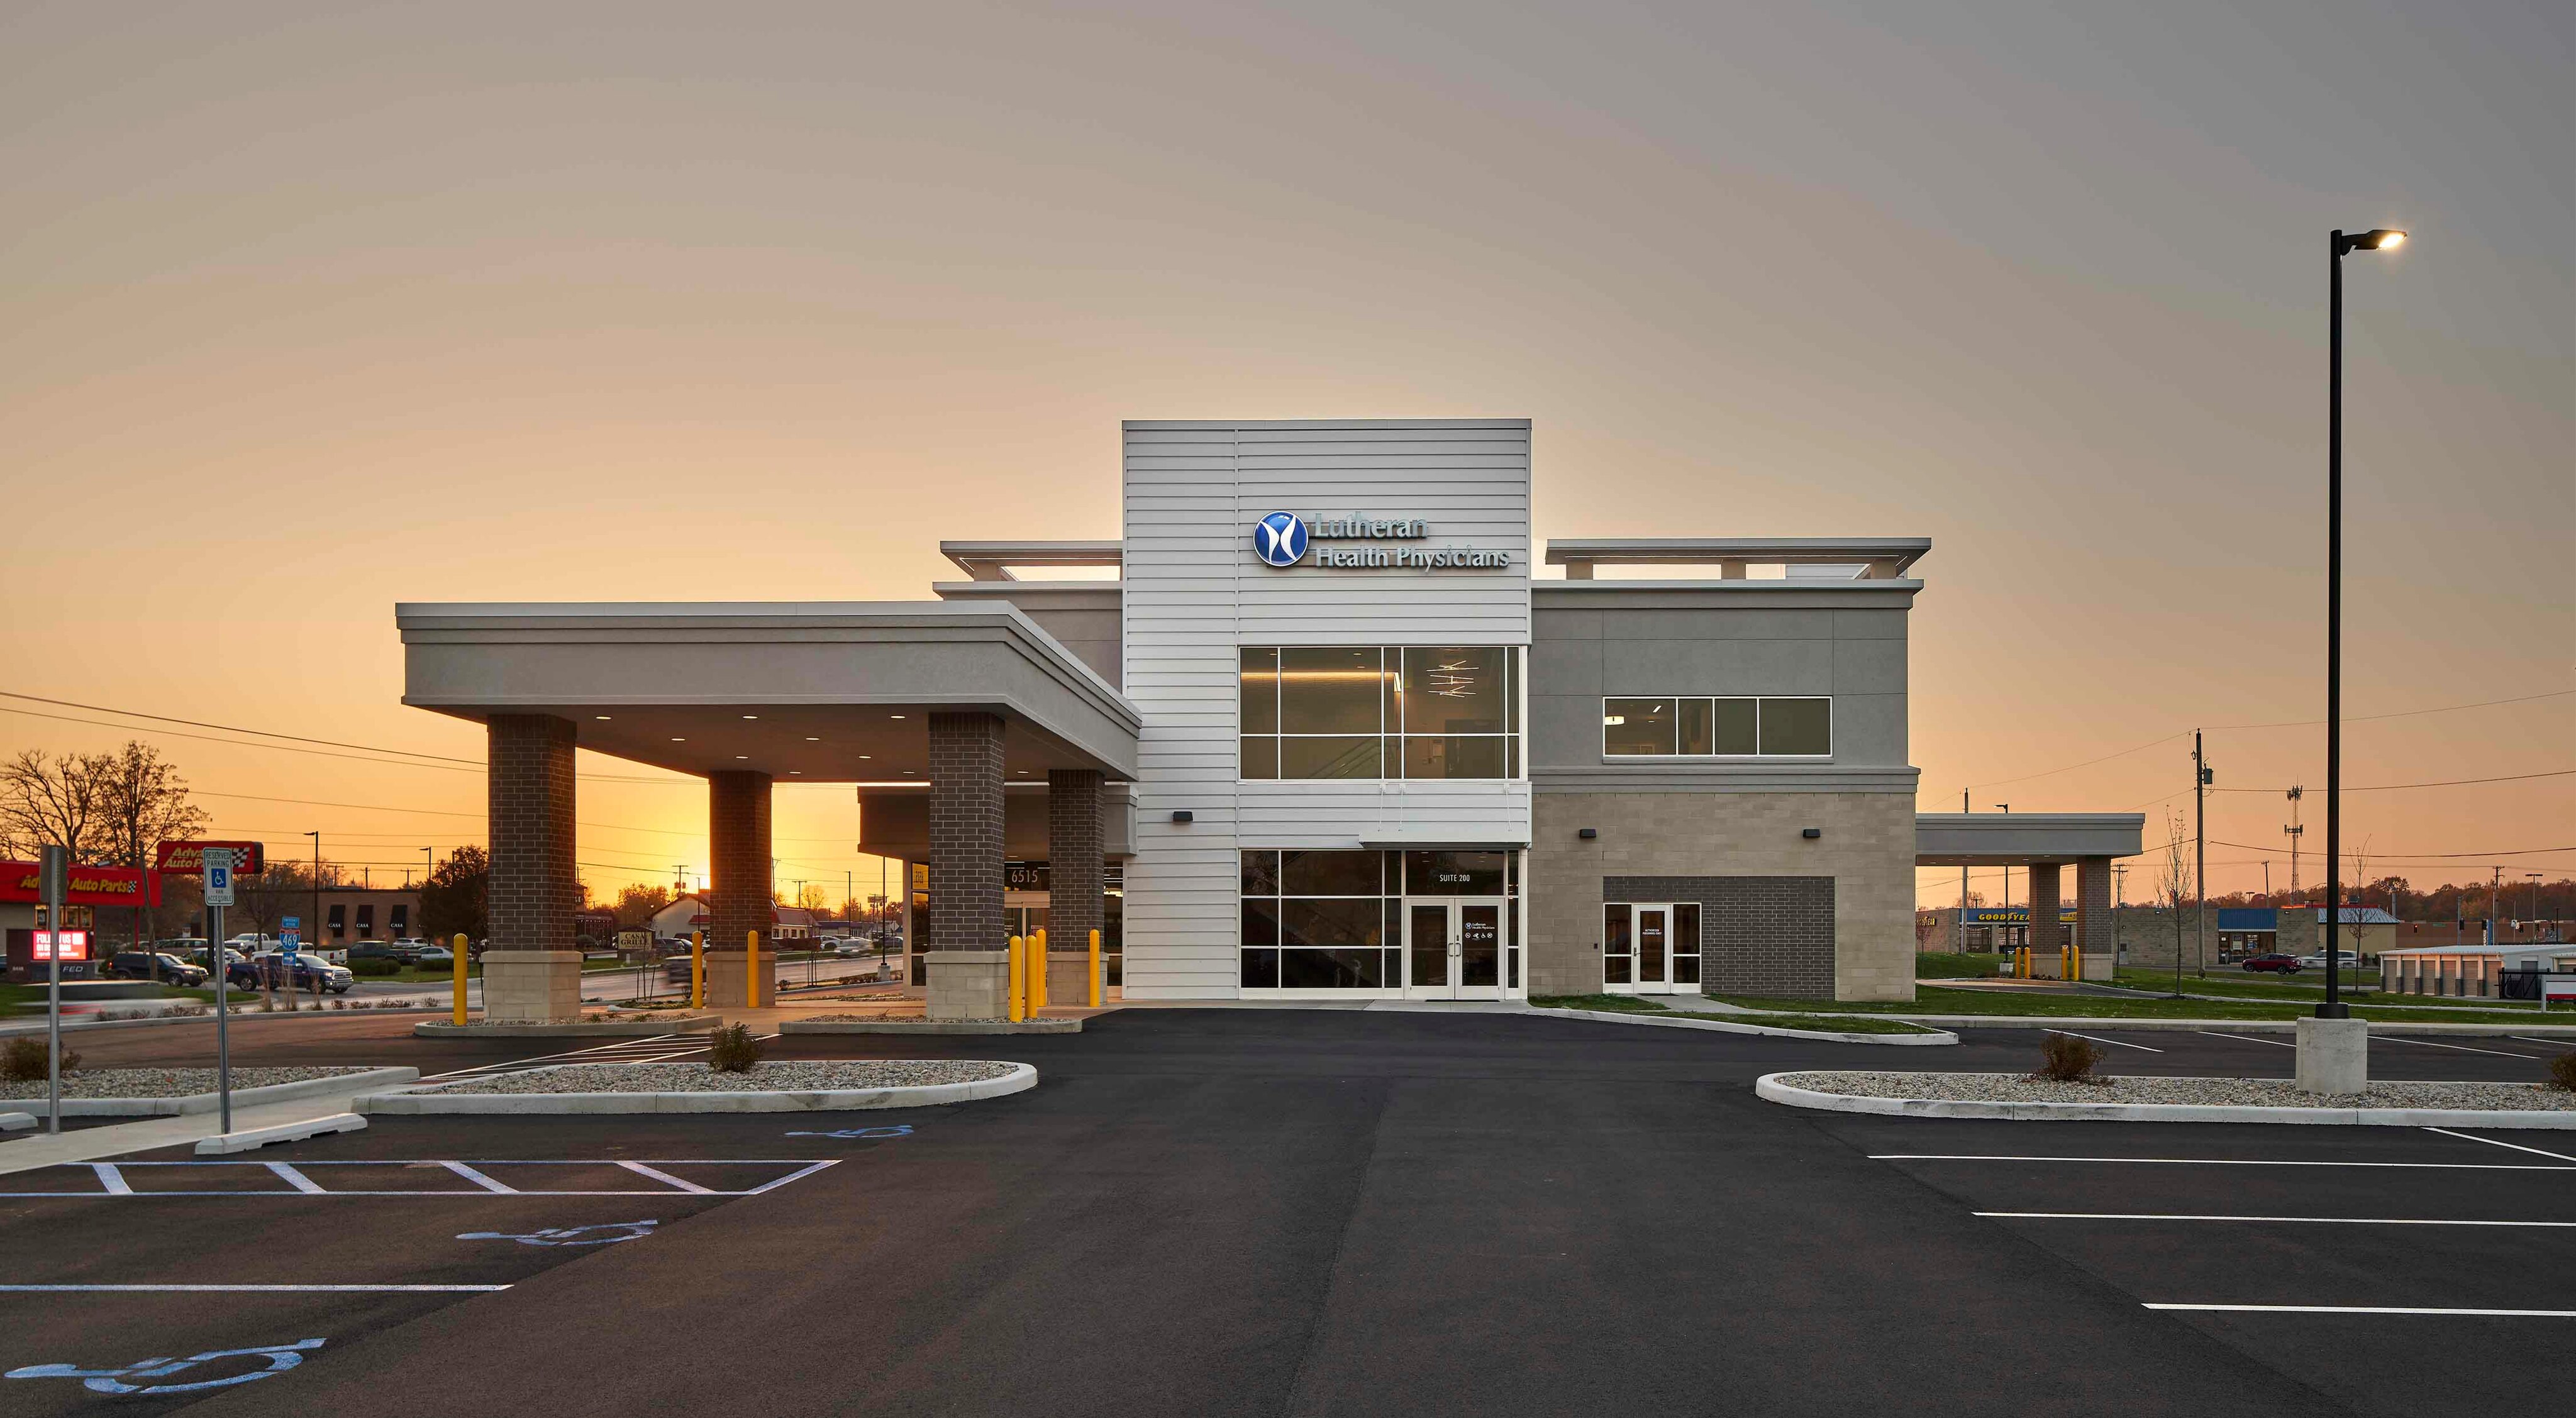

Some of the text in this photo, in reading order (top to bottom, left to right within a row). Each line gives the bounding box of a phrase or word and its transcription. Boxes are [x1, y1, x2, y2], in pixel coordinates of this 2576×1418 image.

[1314, 511, 1428, 538] Lutheran
[1316, 545, 1509, 573] Health Physicians
[172, 846, 204, 857] Adva
[205, 851, 231, 860] RESERVED
[163, 858, 192, 868] Auto
[1011, 870, 1038, 883] 6515
[69, 877, 128, 892] Auto Parts
[283, 934, 297, 946] 469
